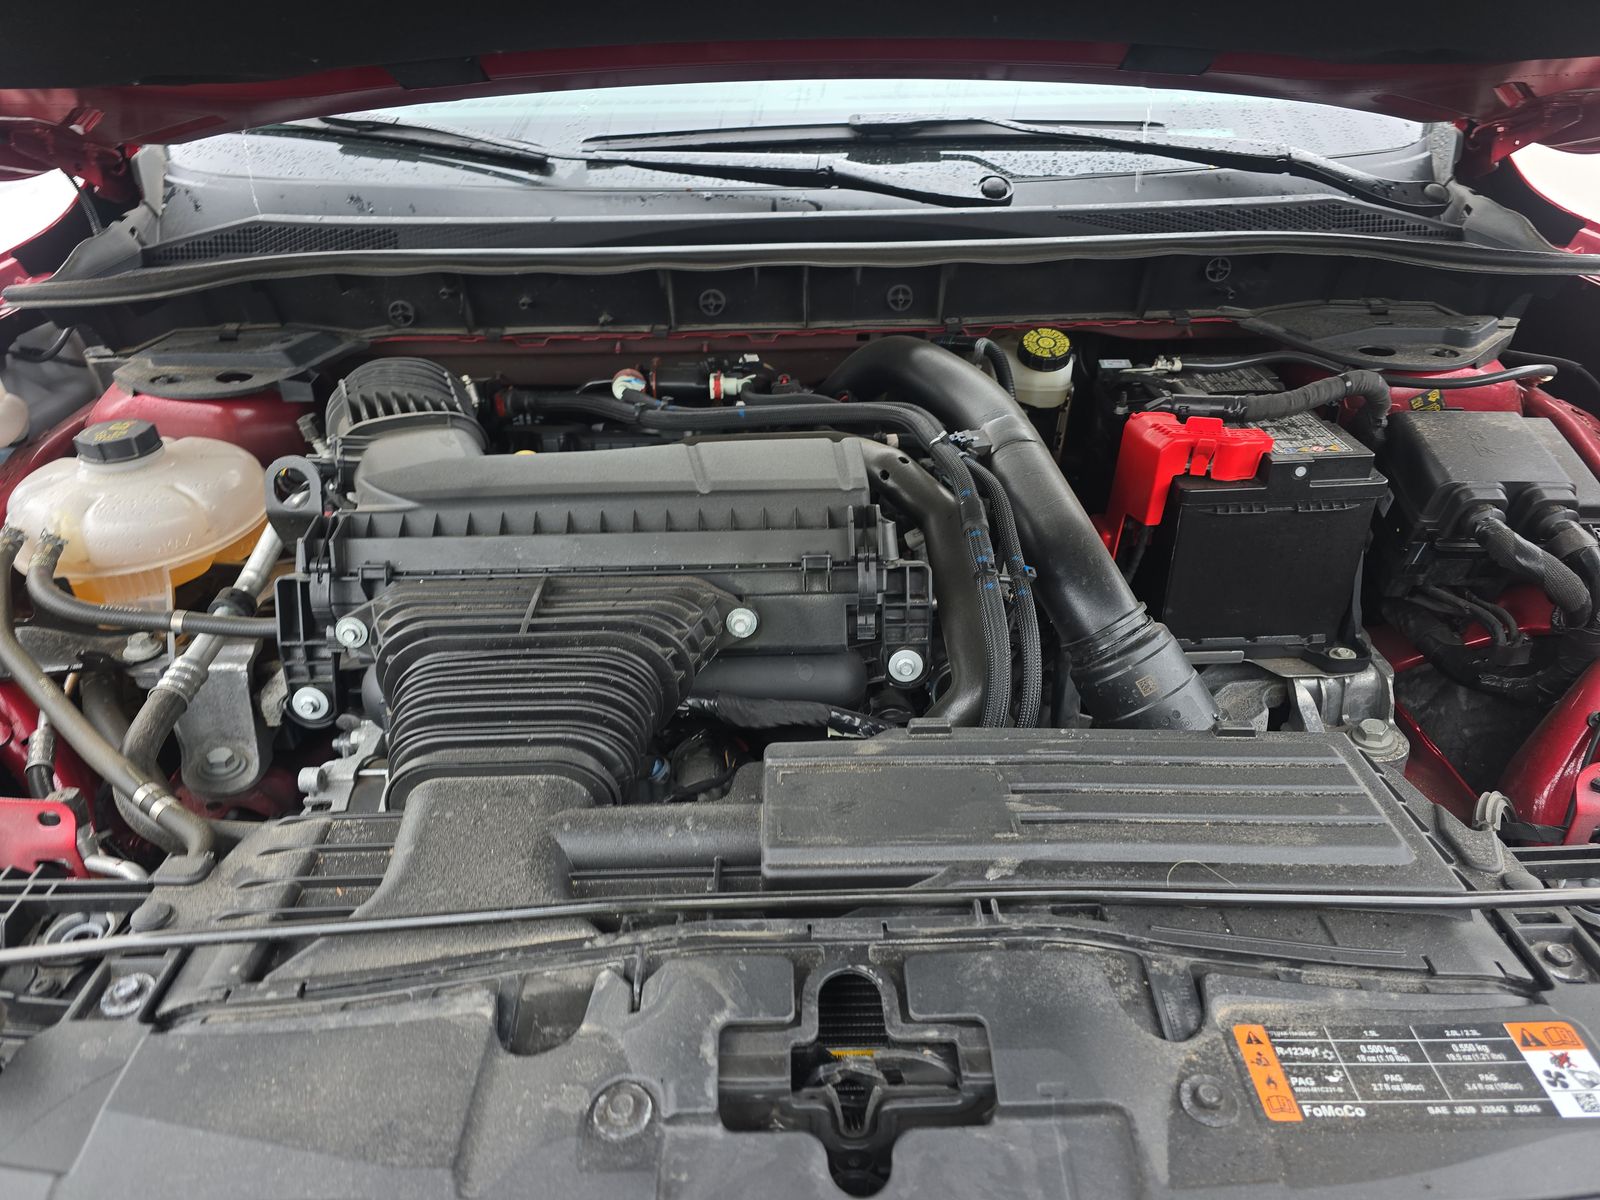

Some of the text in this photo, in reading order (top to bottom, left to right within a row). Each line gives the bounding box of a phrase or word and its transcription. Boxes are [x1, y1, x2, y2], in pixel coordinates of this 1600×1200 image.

[1275, 1046, 1319, 1058] R-1234yf
[1360, 1044, 1398, 1056] 0.500 kg
[1475, 1043, 1491, 1054] kg
[1290, 1076, 1315, 1086] PAG
[1383, 1074, 1404, 1082] PAG
[1301, 1104, 1367, 1118] FoMoCo
[1427, 1105, 1451, 1115] SAE
